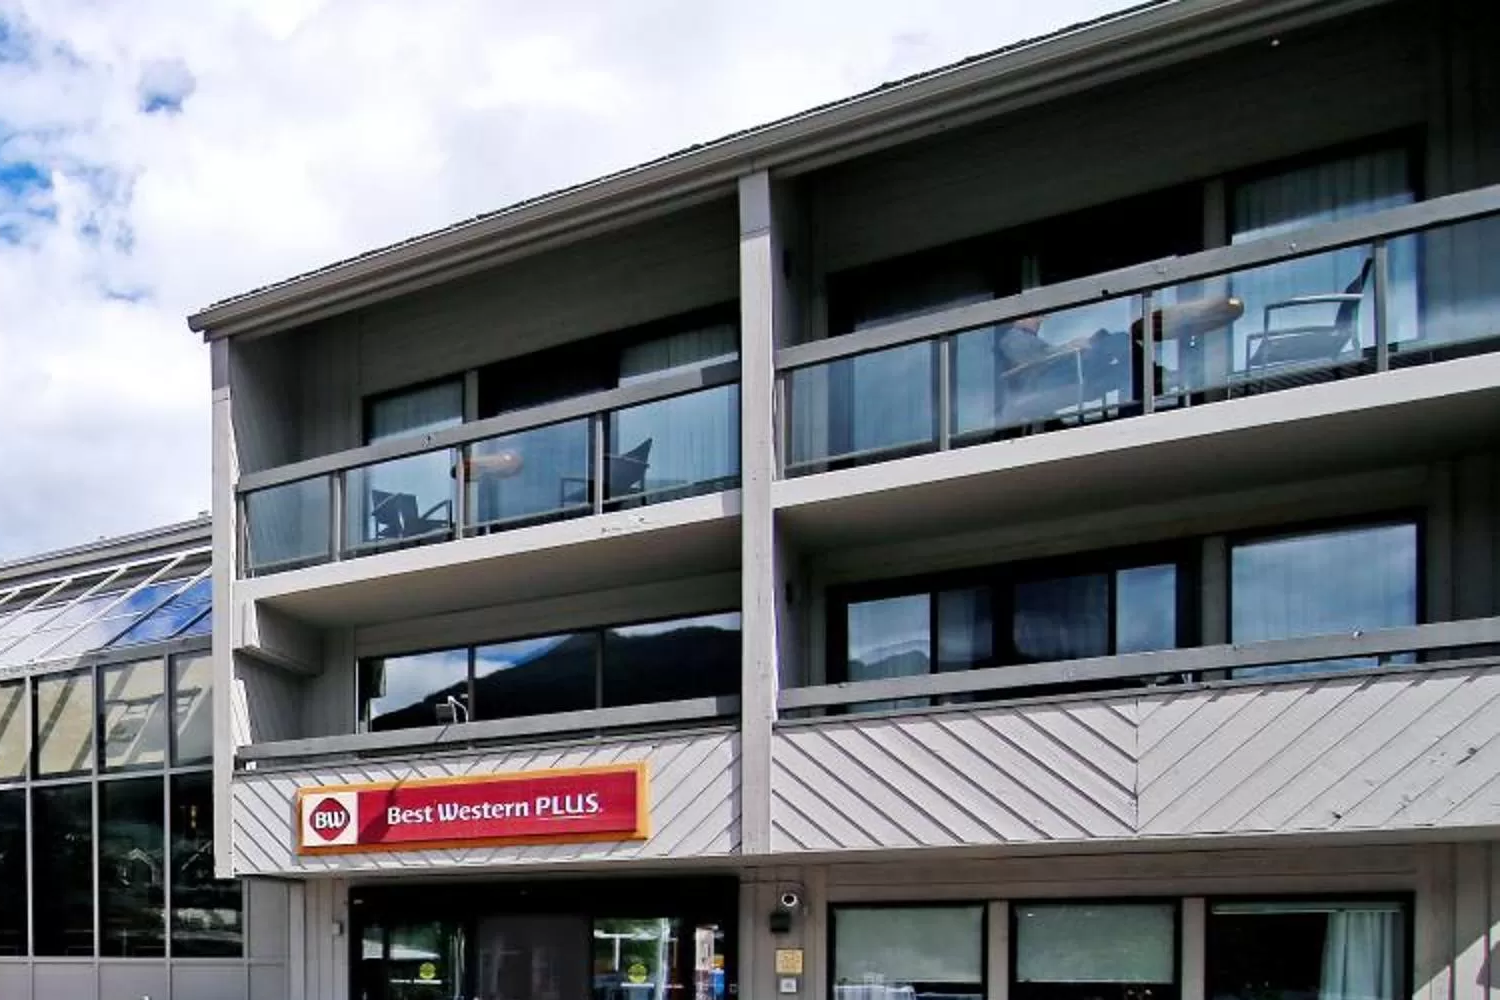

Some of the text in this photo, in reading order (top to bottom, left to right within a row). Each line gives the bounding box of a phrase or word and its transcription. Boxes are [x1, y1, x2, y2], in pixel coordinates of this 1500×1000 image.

[314, 809, 345, 829] BW
[387, 793, 599, 826] Best Western PLUS
